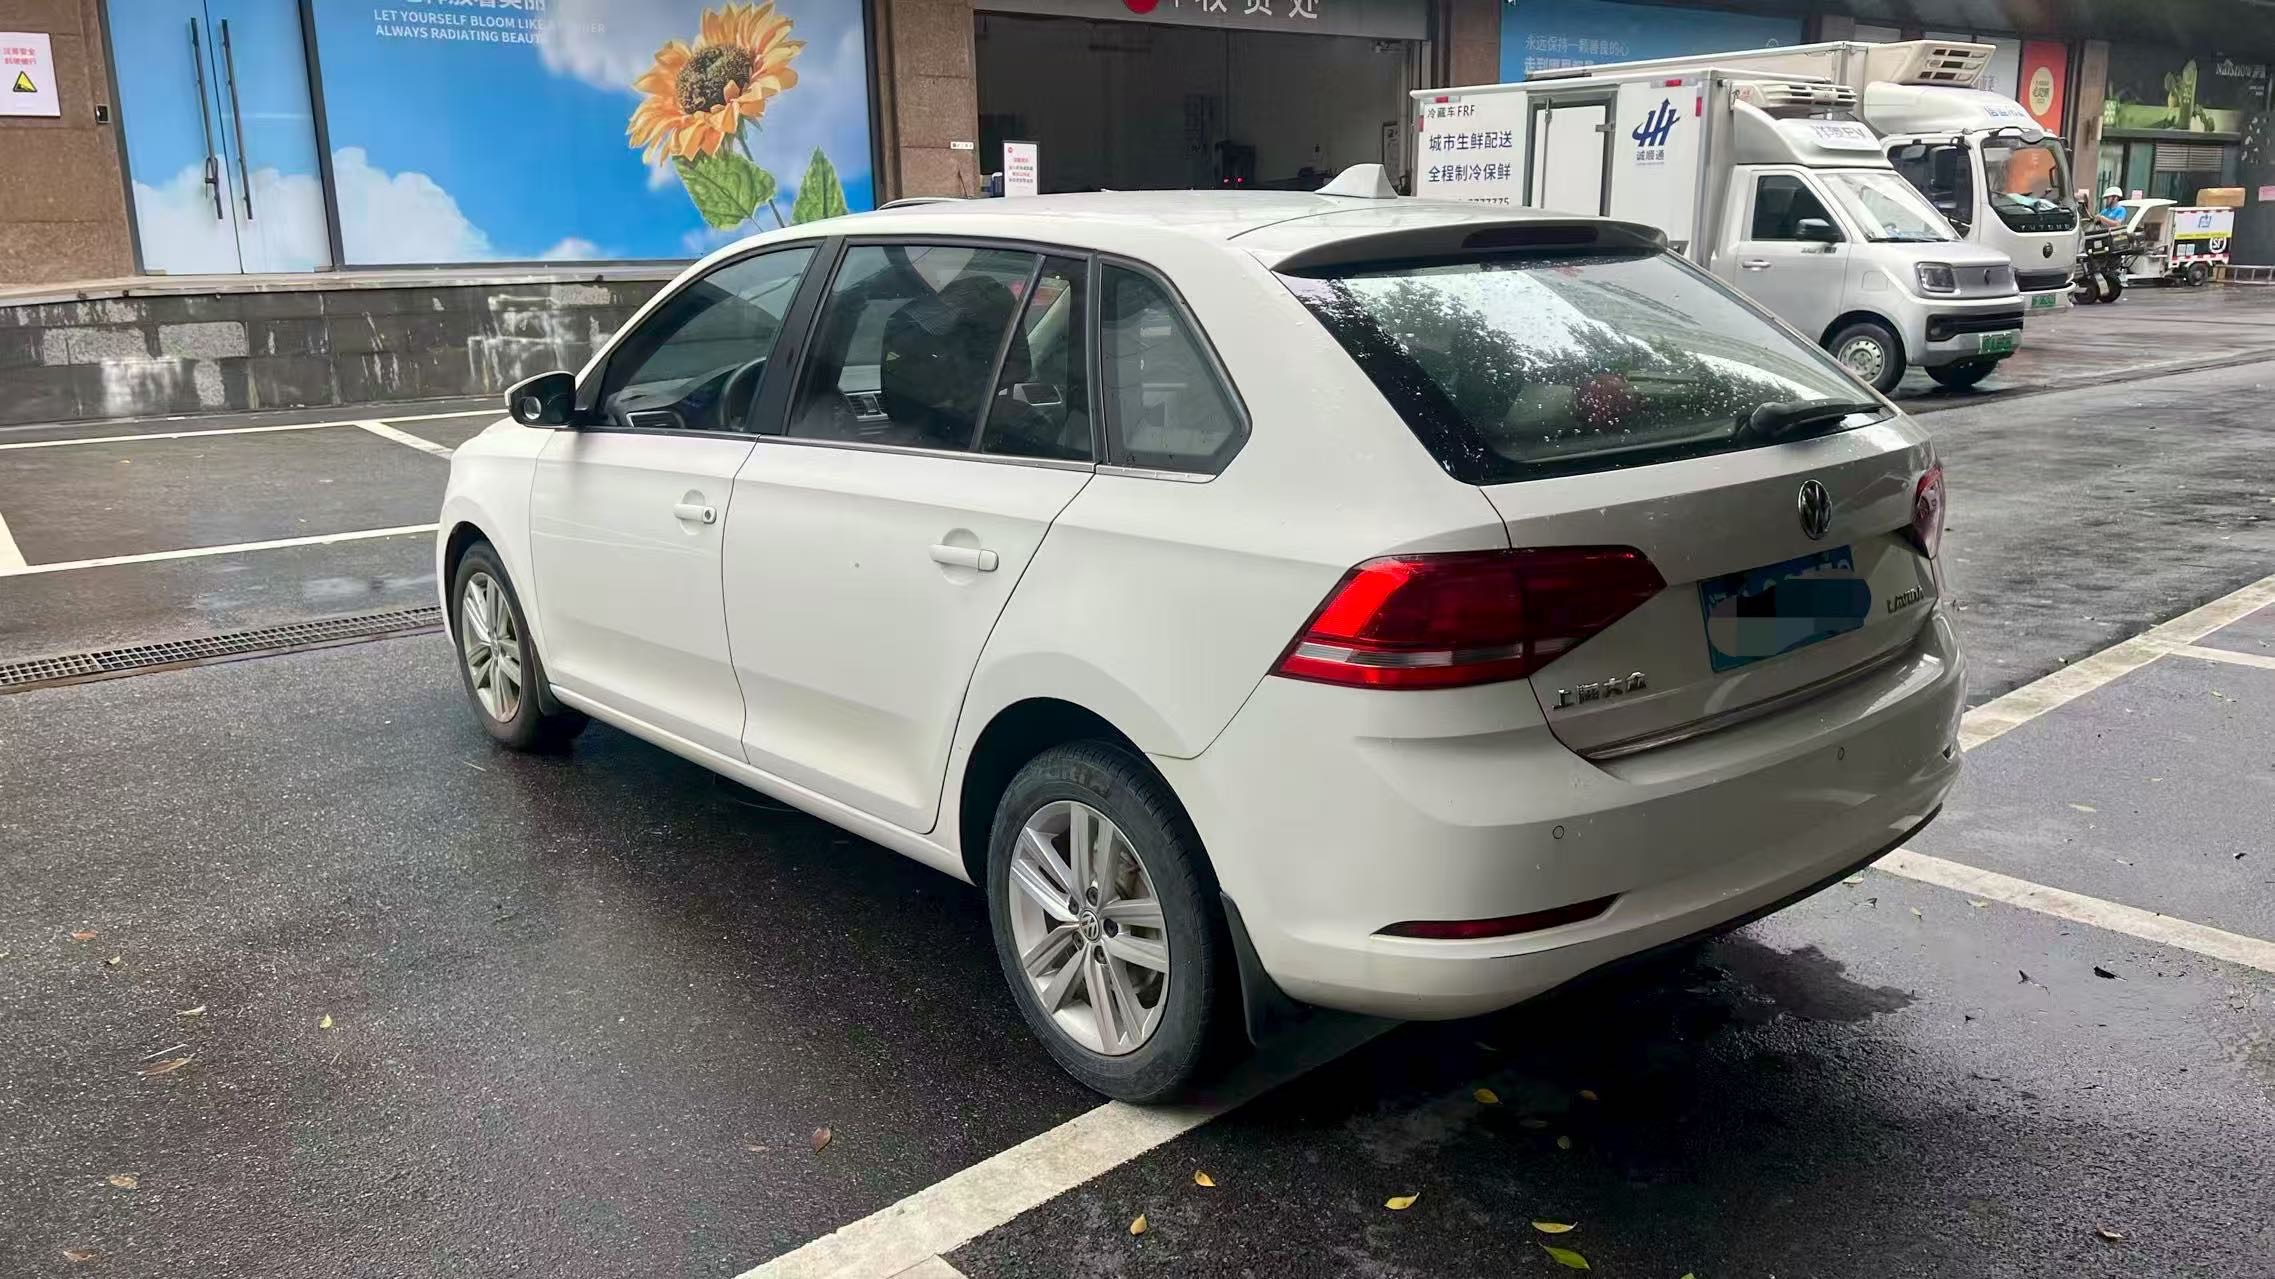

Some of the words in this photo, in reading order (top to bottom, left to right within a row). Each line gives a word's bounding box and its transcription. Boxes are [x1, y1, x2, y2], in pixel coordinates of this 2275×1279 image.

[373, 9, 397, 22] LET
[400, 11, 467, 26] YOURSELF
[470, 16, 515, 29] BLOOM
[518, 18, 545, 31] LIKE
[375, 25, 428, 39] ALWAYS
[431, 27, 499, 43] RADIATING
[1429, 130, 1512, 152] 城市生鲜配送
[1636, 149, 1664, 160] 诚顺通
[1428, 163, 1511, 183] 全程制冷保鲜
